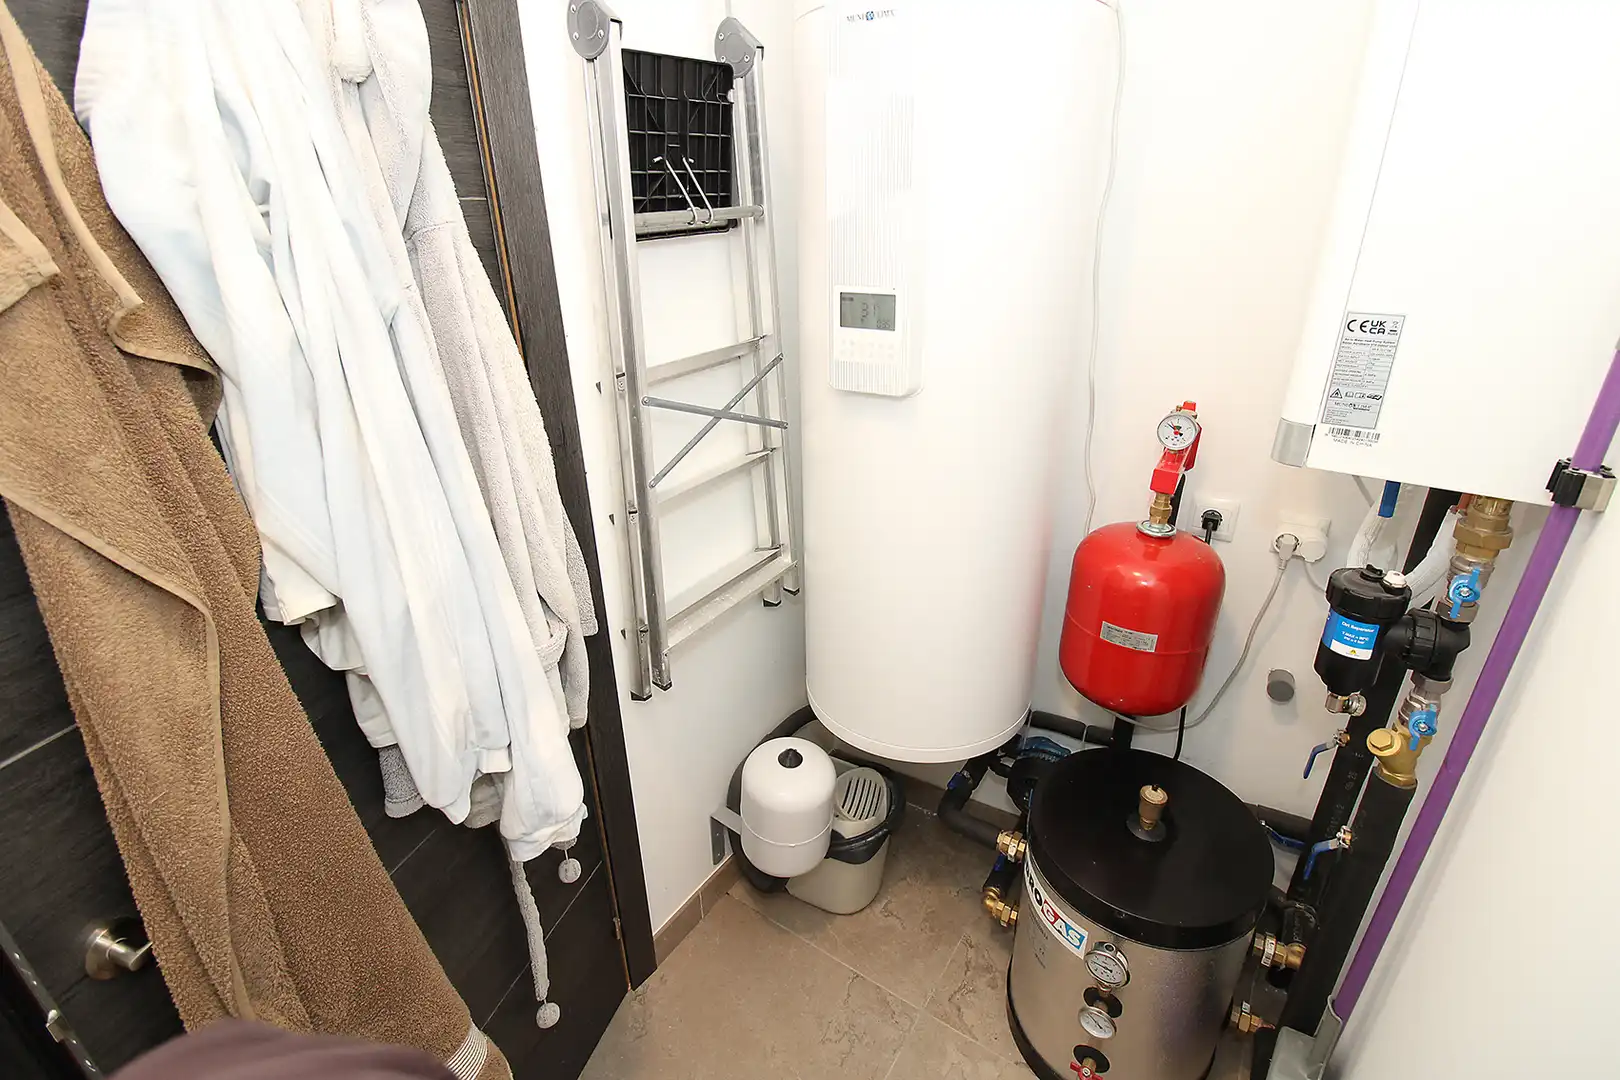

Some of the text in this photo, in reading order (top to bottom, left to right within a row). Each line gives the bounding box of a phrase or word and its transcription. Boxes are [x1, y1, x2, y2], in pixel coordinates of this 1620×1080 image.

[1347, 319, 1370, 333] CE
[1370, 320, 1387, 328] UK
[1369, 327, 1386, 335] CA
